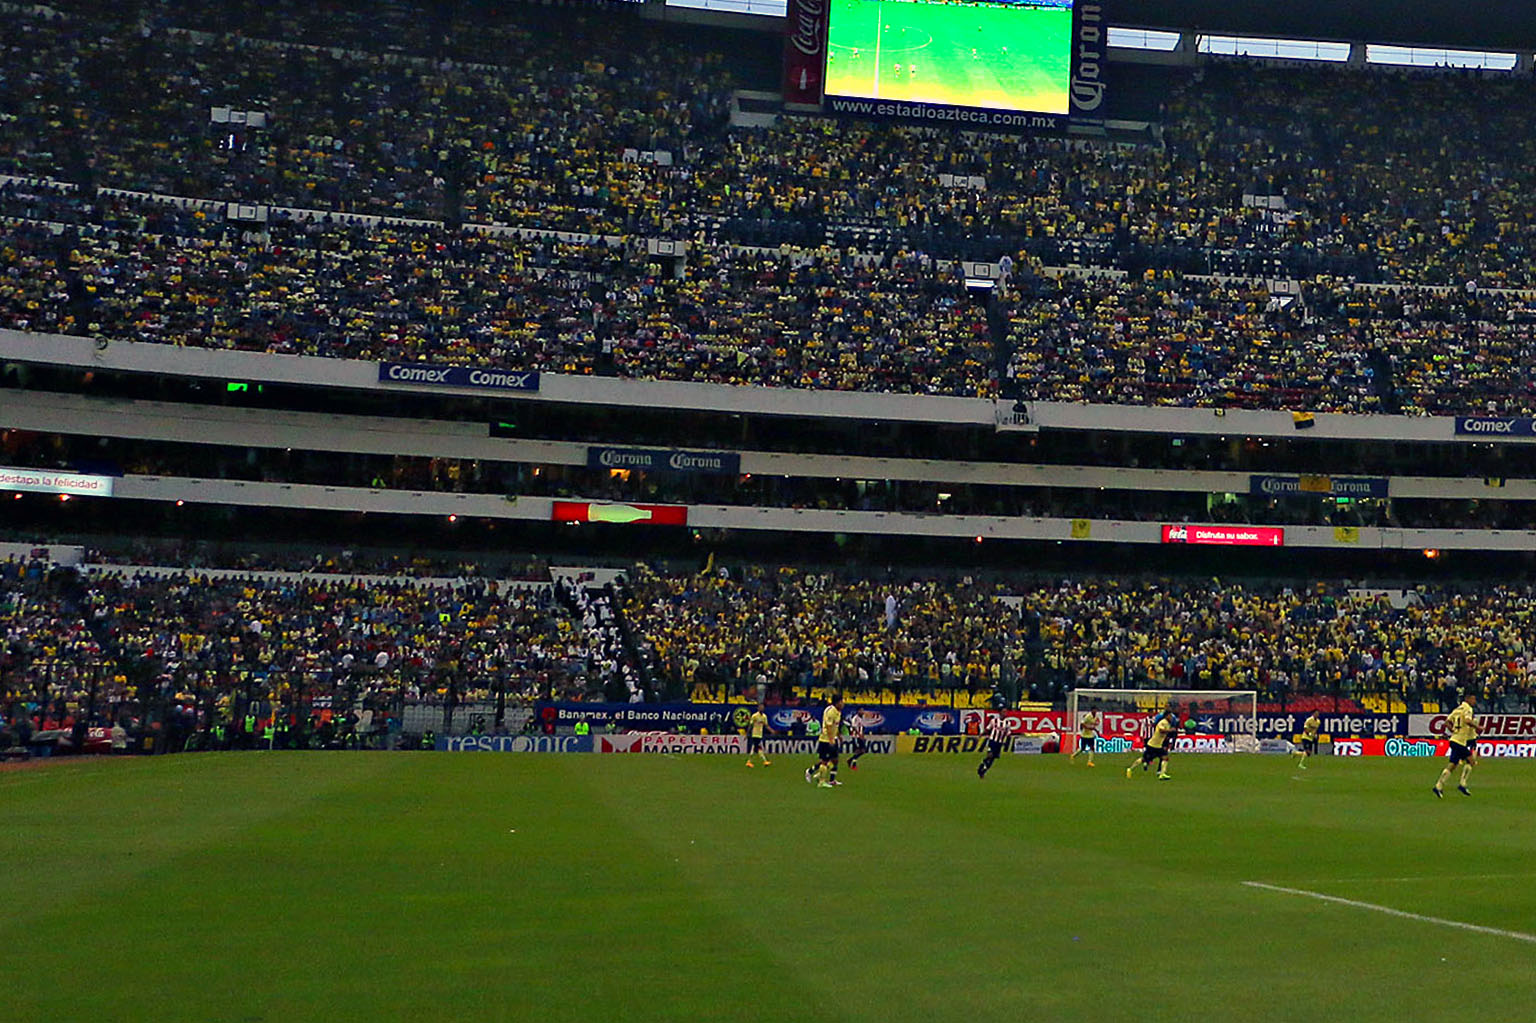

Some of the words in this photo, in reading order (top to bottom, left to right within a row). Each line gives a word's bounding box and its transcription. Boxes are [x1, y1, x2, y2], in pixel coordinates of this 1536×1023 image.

[832, 99, 1056, 129] www.estadioazteca.com.mx
[389, 365, 451, 383] Comex
[469, 370, 531, 388] Comex
[1463, 418, 1516, 433] Comex
[600, 449, 652, 466] Corona
[669, 453, 721, 469] Corona
[42, 477, 52, 485] la
[54, 478, 98, 489] felicidad
[1261, 477, 1300, 493] Coron
[615, 710, 625, 719] el
[628, 710, 660, 720] Banco
[662, 711, 707, 721] Nacional
[1385, 737, 1437, 756] O'Reilly
